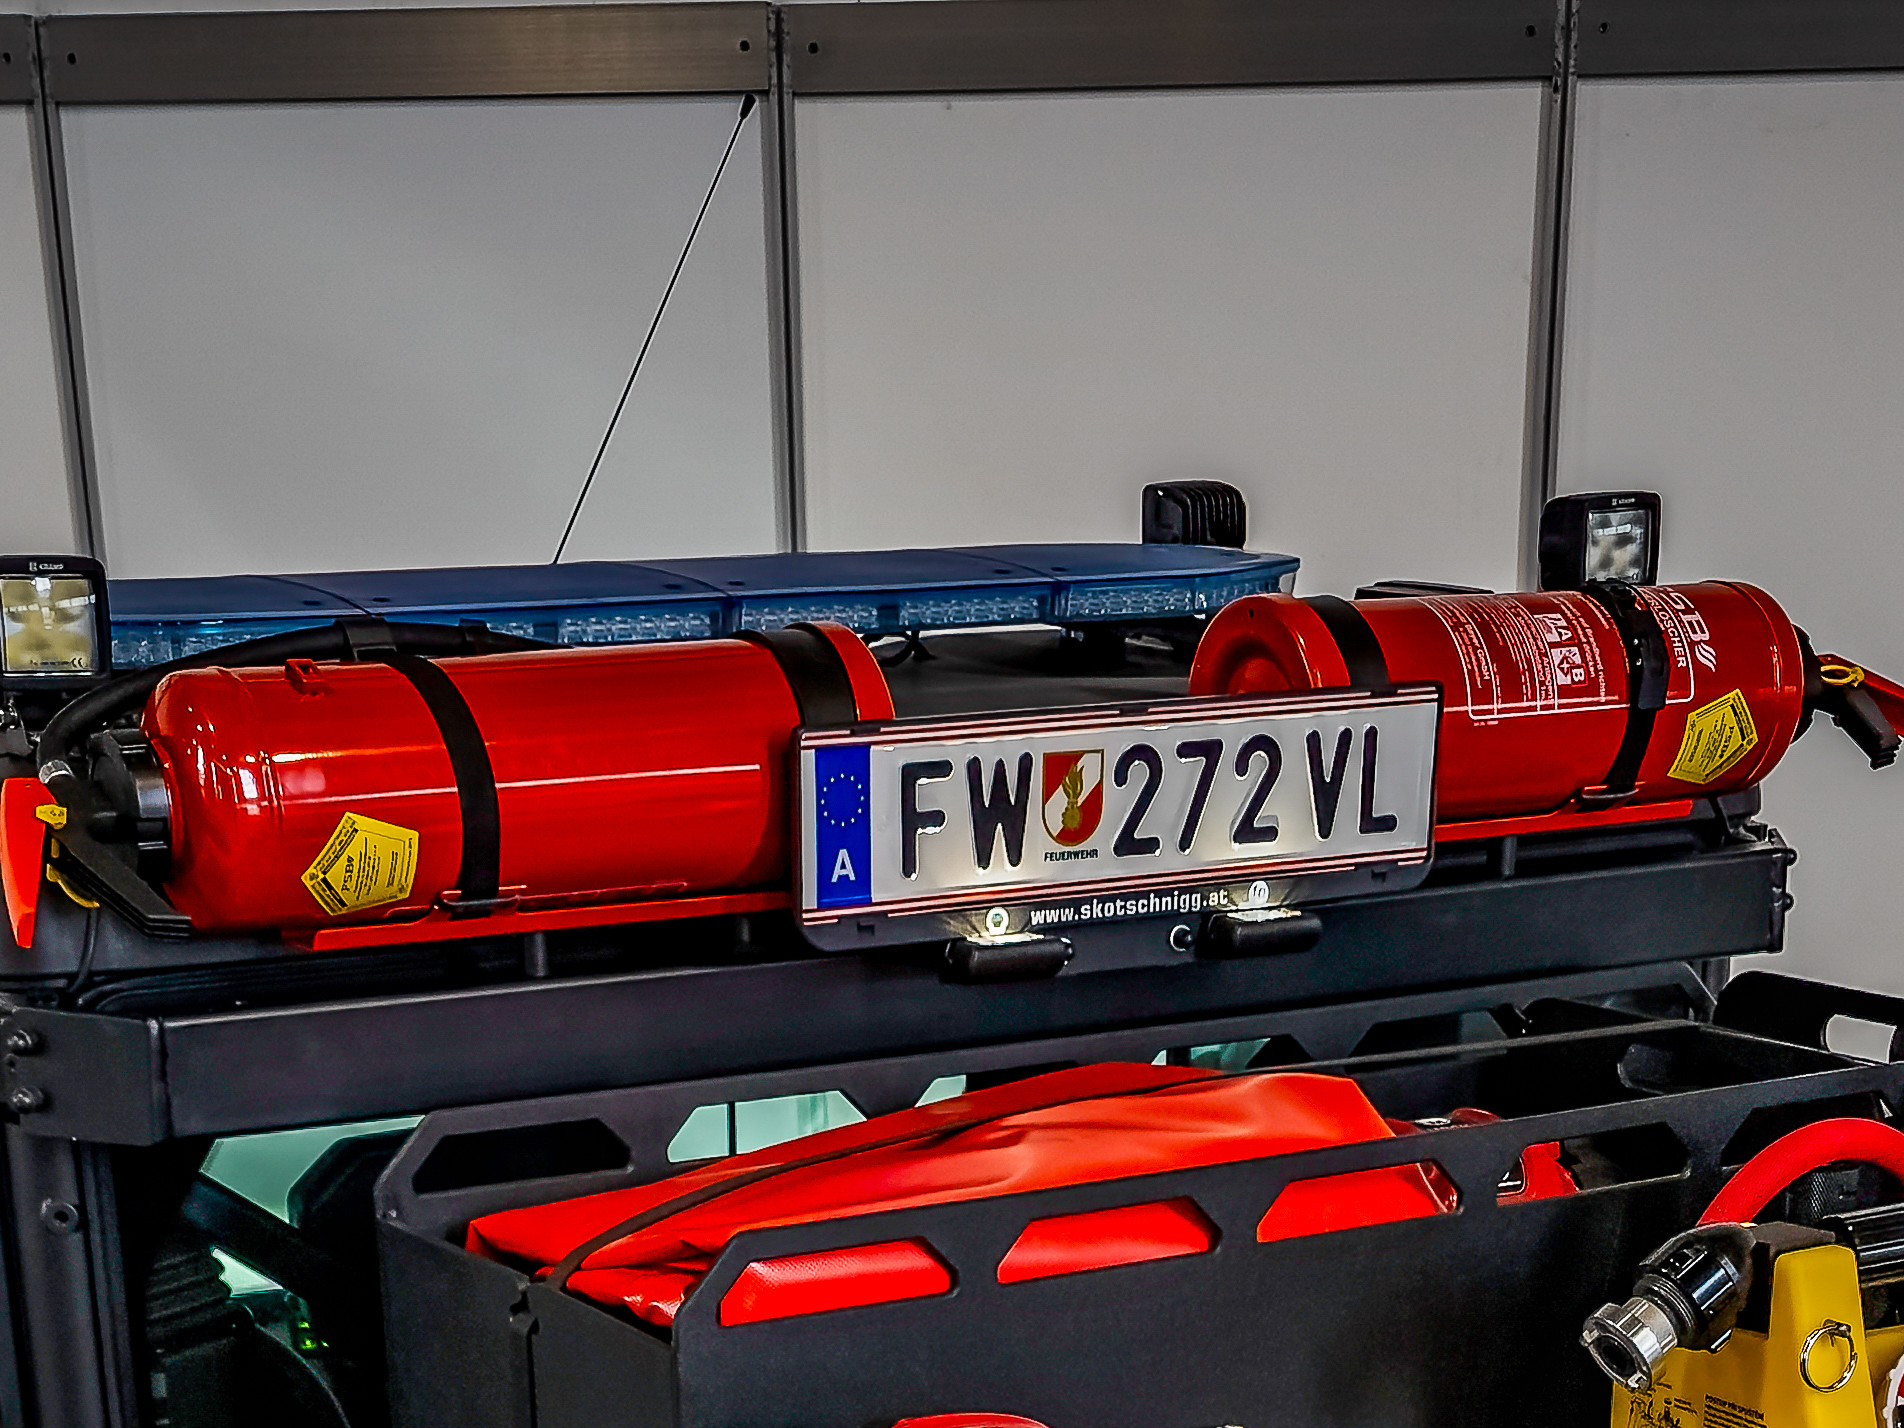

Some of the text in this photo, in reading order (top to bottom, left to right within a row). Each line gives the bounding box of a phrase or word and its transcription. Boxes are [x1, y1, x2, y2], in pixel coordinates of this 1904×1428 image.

[1558, 627, 1573, 641] A
[1573, 668, 1585, 682] B
[899, 723, 1398, 880] FW 272 VL
[830, 848, 856, 883] A
[1044, 849, 1099, 862] FEUERWEHR
[1030, 889, 1229, 926] www.skotschnigg.at
